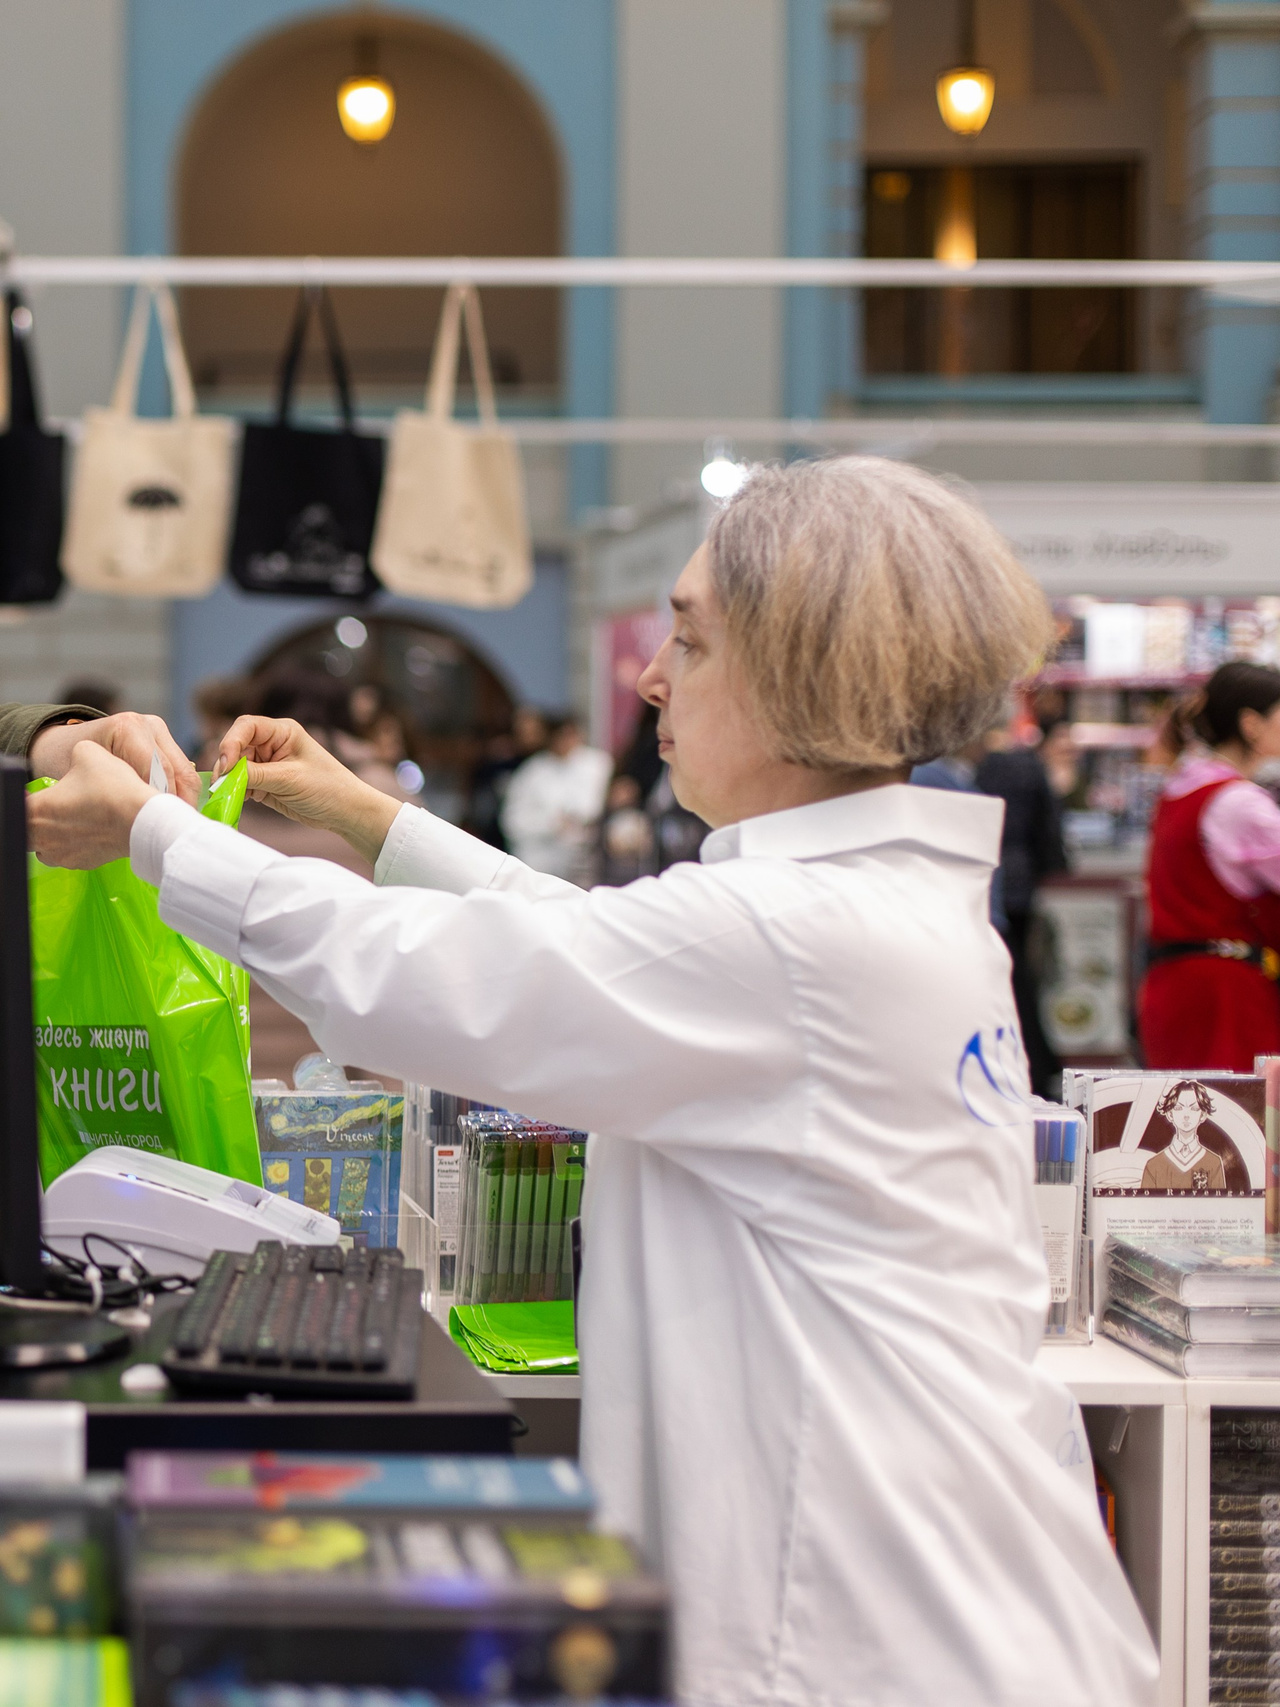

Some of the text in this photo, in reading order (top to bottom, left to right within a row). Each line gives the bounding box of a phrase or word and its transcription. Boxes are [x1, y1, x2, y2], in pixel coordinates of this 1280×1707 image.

[35, 1016, 150, 1057] здесь живут
[50, 1067, 163, 1114] книги
[326, 1124, 374, 1143] Vincent
[1095, 1188, 1266, 1197] Tokyo Revengers
